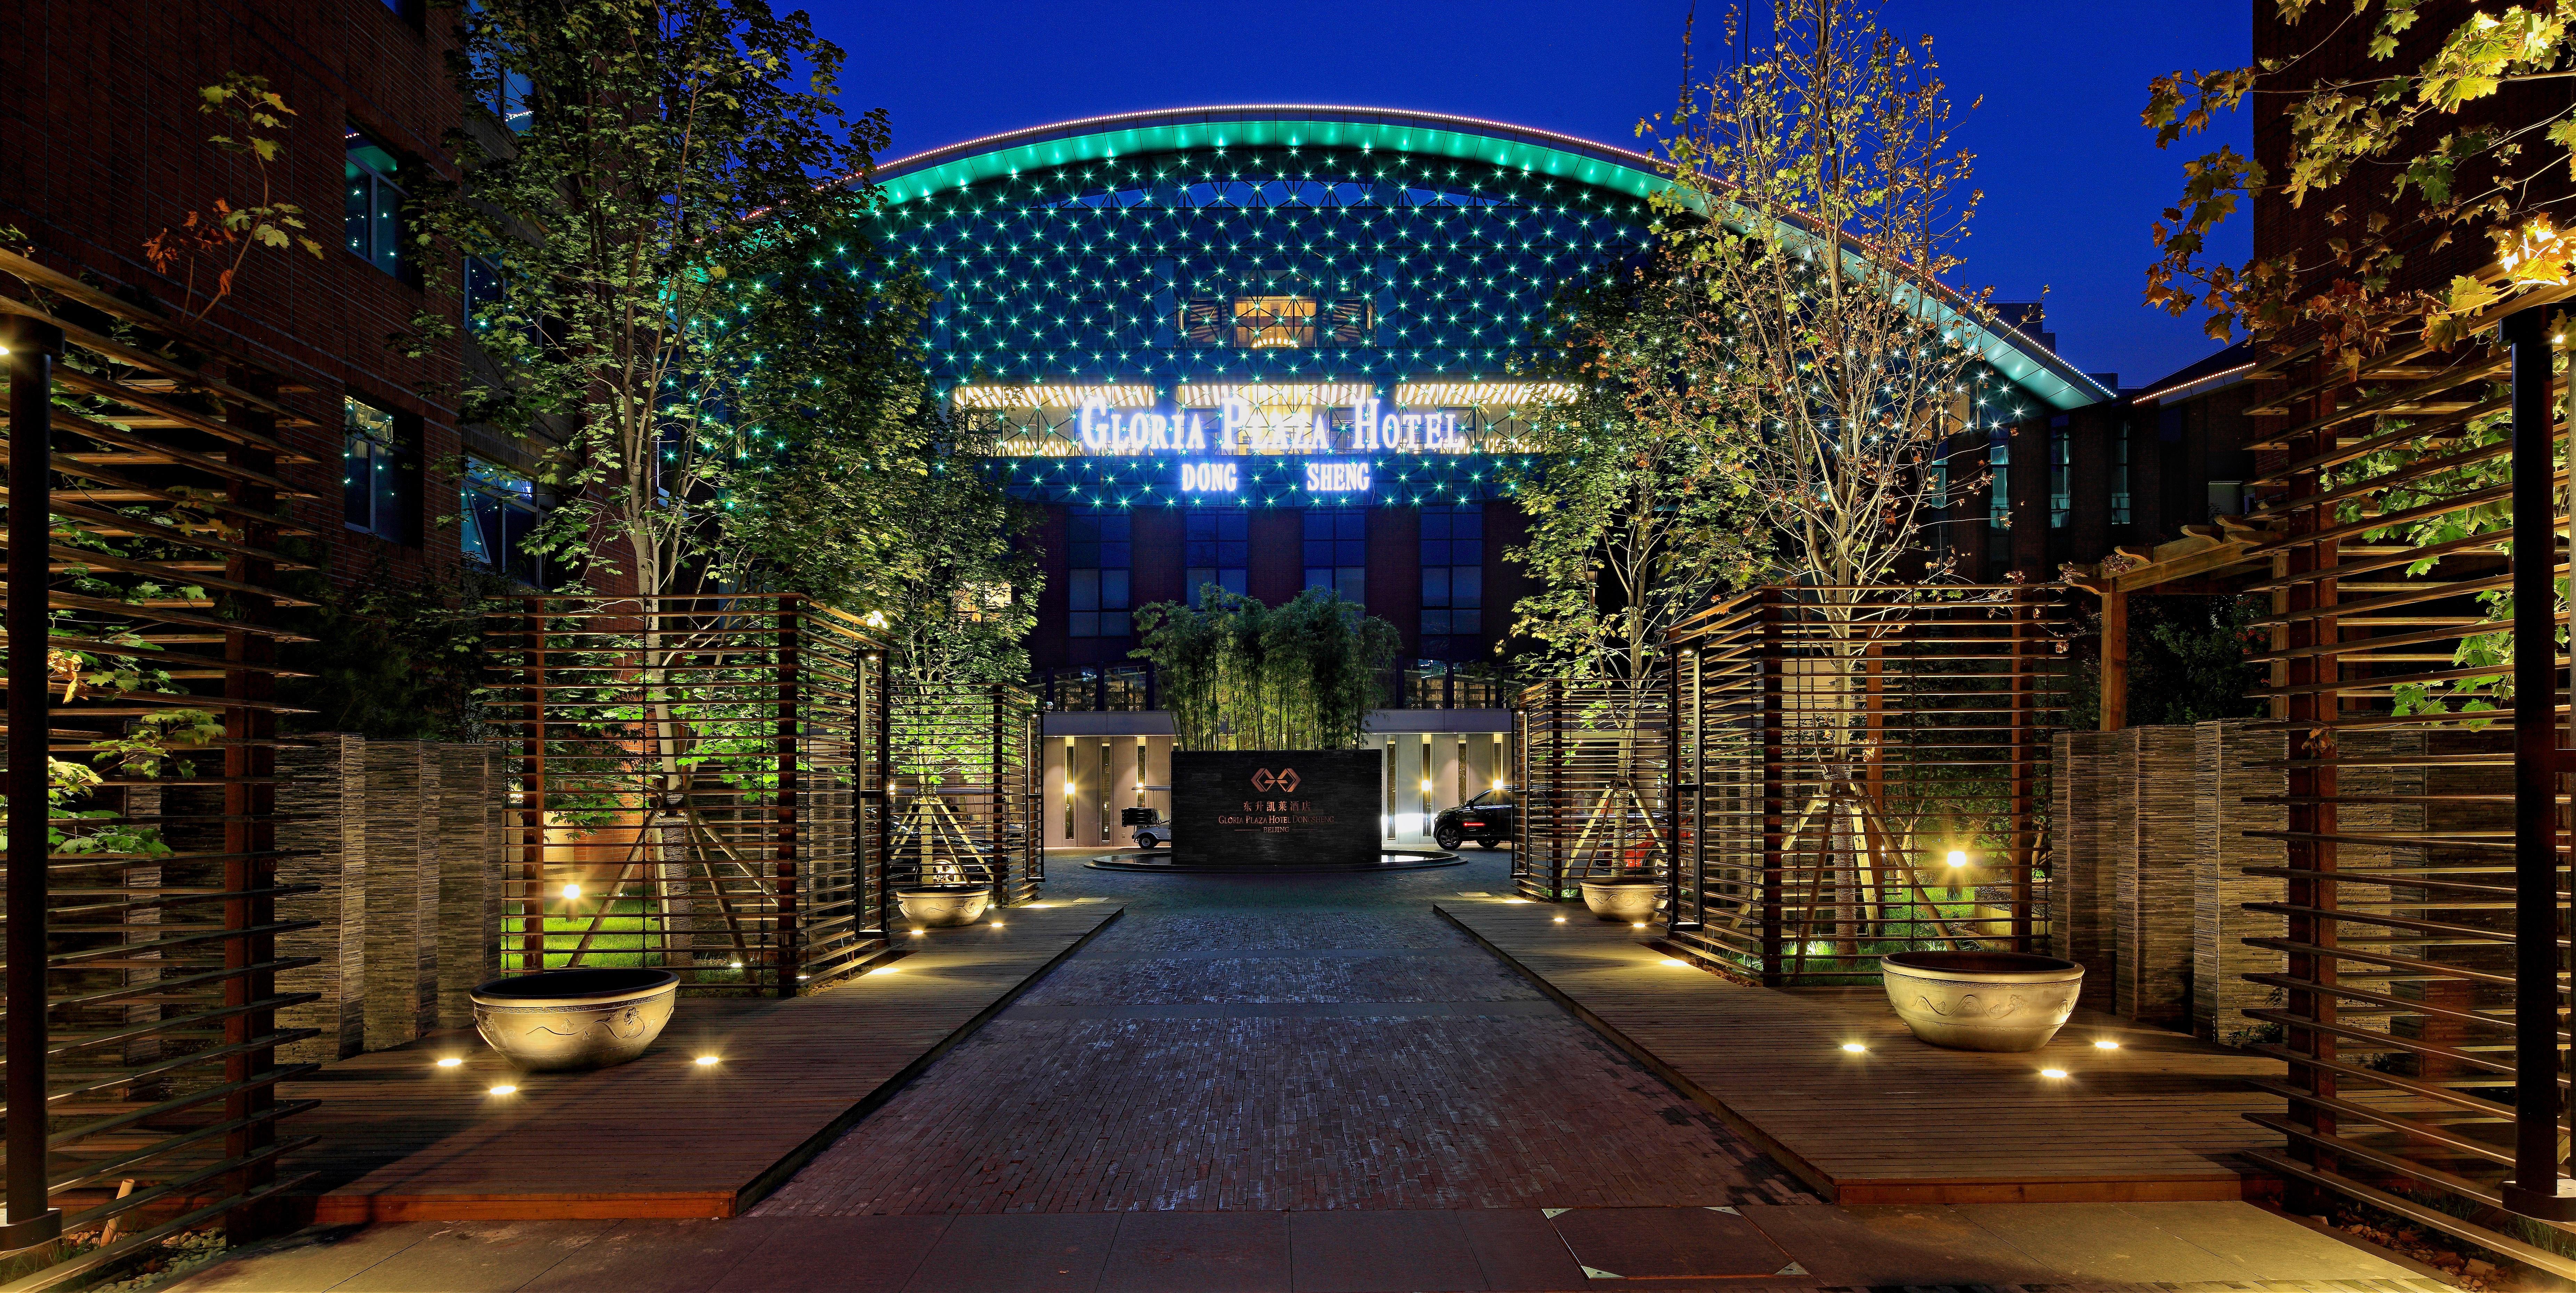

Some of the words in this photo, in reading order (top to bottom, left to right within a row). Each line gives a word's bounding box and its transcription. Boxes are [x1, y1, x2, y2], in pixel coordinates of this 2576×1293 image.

[1082, 396, 1205, 449] GLORIA
[1221, 397, 1330, 449] PLAZA
[1352, 398, 1465, 449] HOTEL
[1182, 463, 1238, 491] DONG
[1307, 463, 1370, 491] SHENG
[1243, 801, 1311, 812] 东升凯莱酒店
[1218, 815, 1243, 824] GLORIA
[1246, 815, 1267, 824] PLAZA
[1269, 815, 1291, 824] HOTEL
